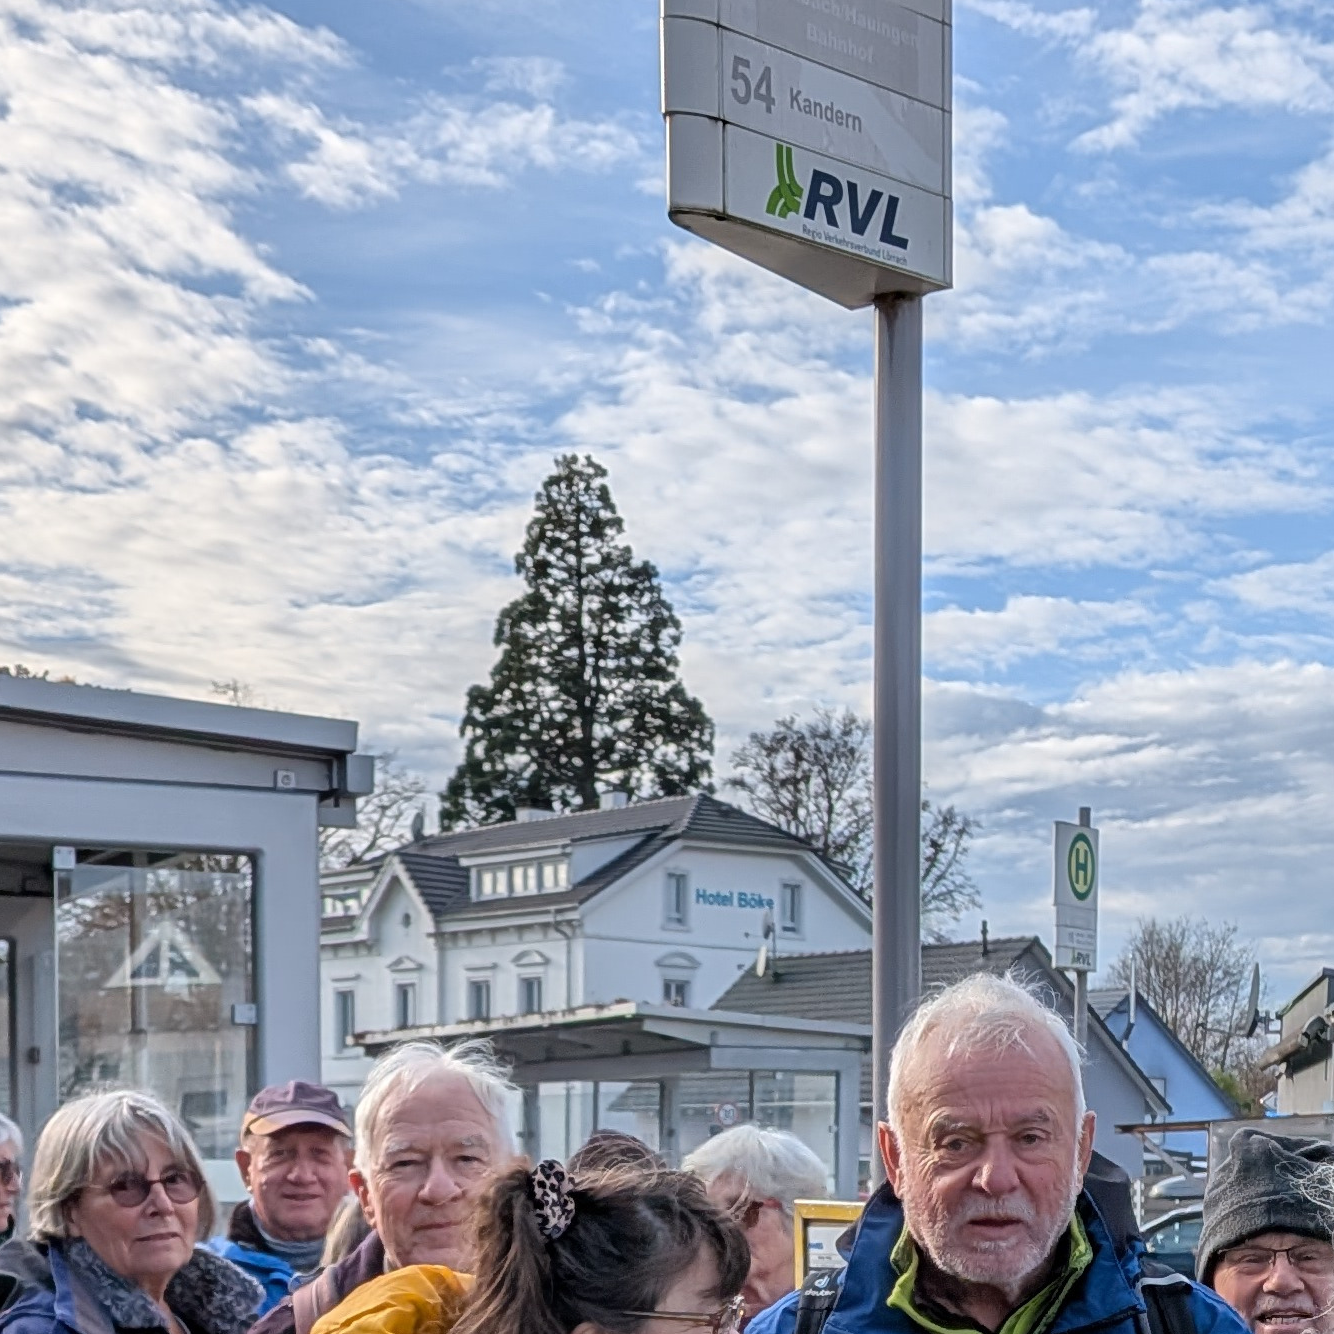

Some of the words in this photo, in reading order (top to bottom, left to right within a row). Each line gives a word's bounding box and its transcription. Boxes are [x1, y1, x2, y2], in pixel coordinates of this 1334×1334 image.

[731, 55, 775, 114] 54
[789, 87, 862, 133] Kandern
[802, 224, 822, 240] Regio
[804, 169, 909, 250] RVL
[695, 888, 734, 908] Hotel
